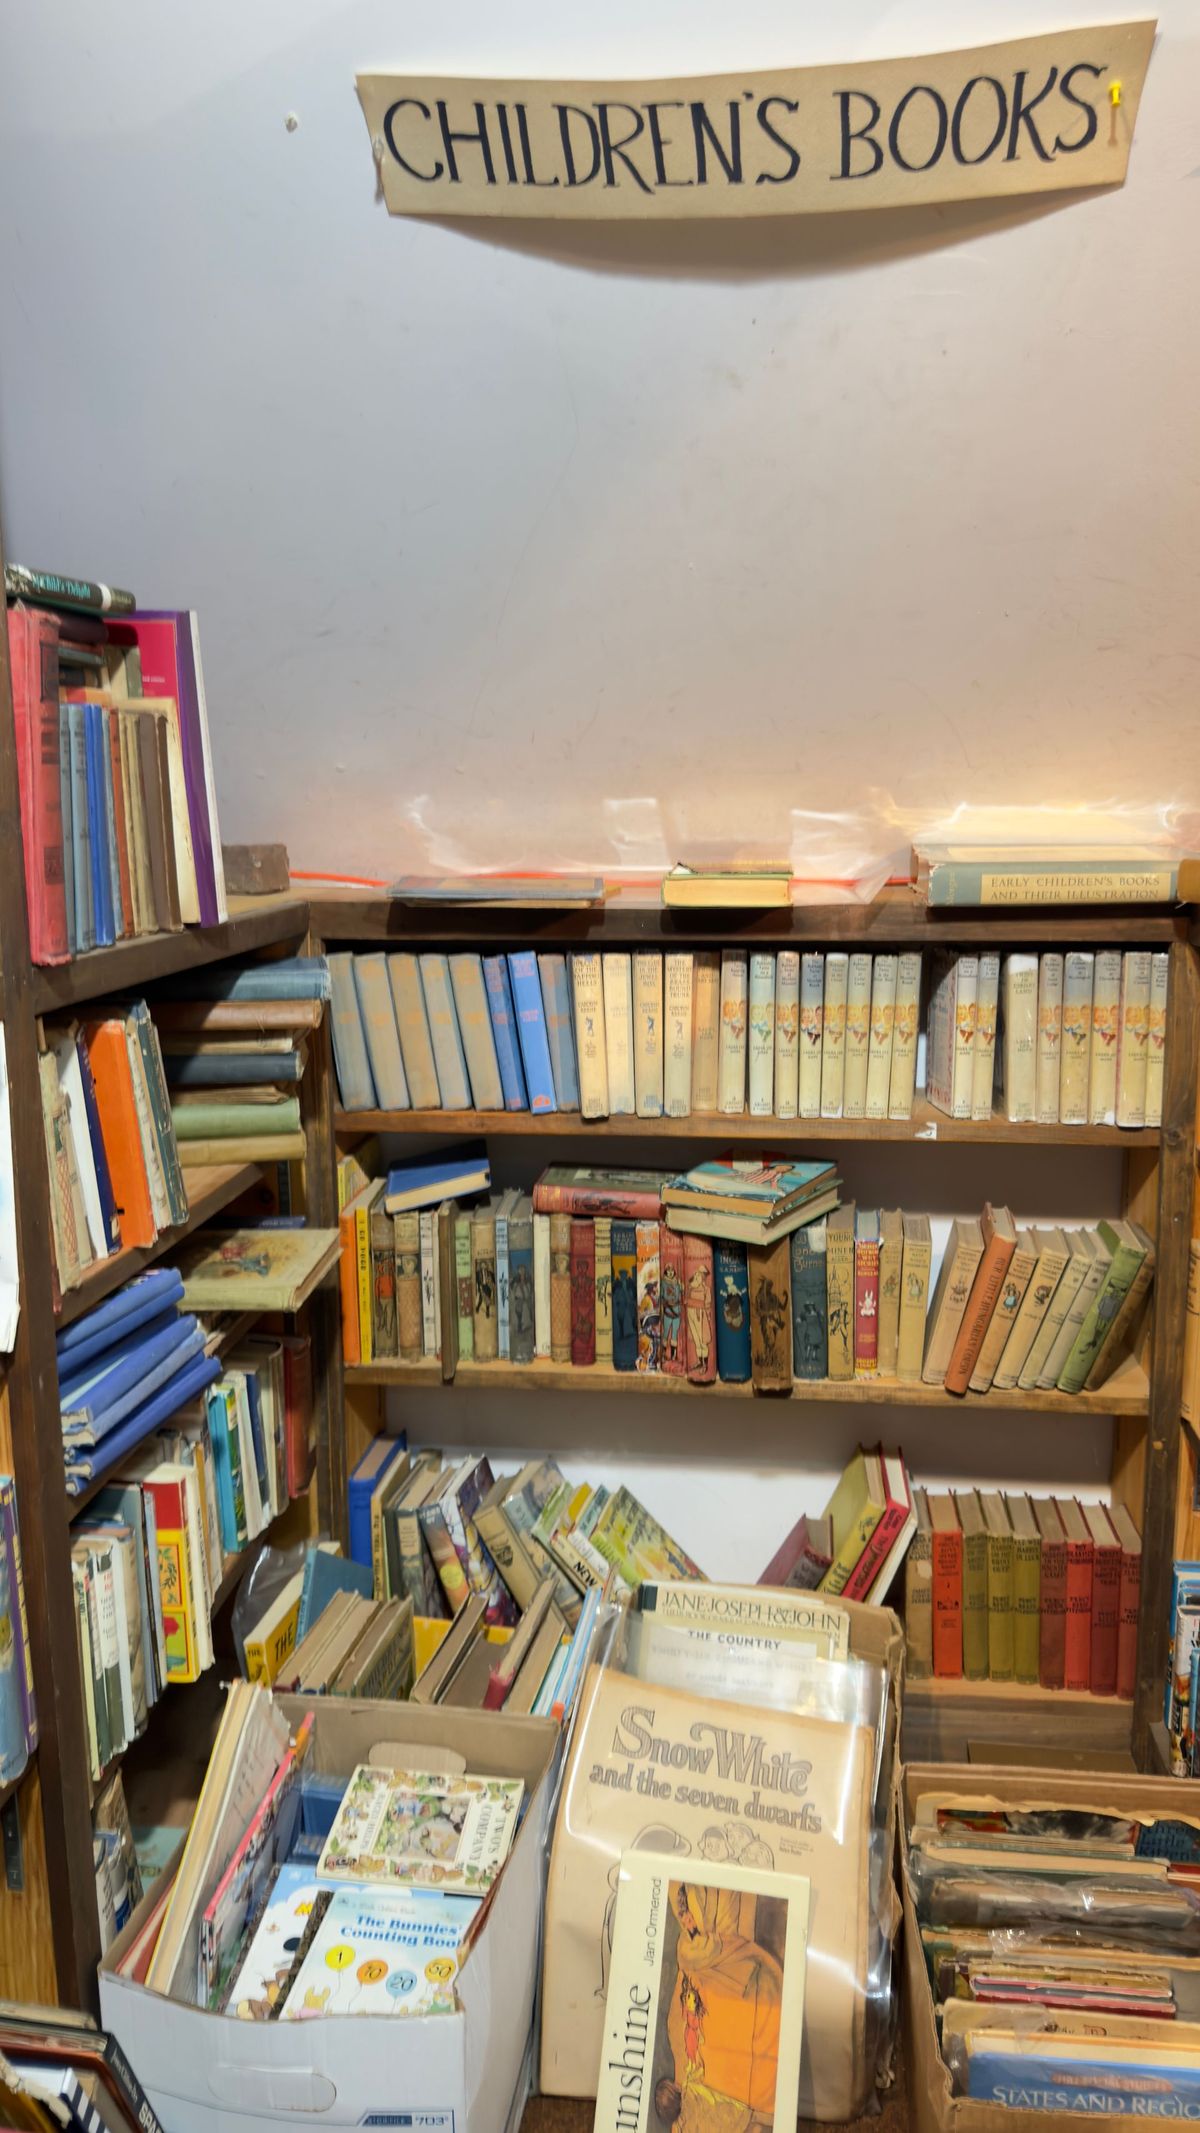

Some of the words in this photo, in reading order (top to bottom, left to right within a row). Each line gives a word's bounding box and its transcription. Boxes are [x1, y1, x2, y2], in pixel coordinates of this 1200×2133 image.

[383, 91, 801, 194] CHILDREN'S
[830, 63, 1107, 182] BOOKS
[991, 876, 1029, 888] EARLY
[1036, 875, 1113, 888] CHILDREN'S
[1119, 874, 1160, 887] BOOKS
[991, 890, 1018, 901] AND
[1024, 889, 1061, 900] THEIR
[1066, 888, 1159, 900] ILLUSTRATION
[574, 1561, 597, 1587] NEW
[274, 1622, 295, 1664] THE
[688, 1630, 711, 1641] THE
[718, 1634, 781, 1650] COUNTRY
[612, 1705, 715, 1774] Snow
[689, 1721, 813, 1797] White
[589, 1761, 633, 1791] and
[637, 1766, 672, 1800] the
[674, 1784, 740, 1816] seven
[744, 1790, 822, 1834] dwarfs
[469, 1803, 493, 1861] COMPANY
[645, 1877, 662, 1938] Ormerod
[340, 1926, 418, 1947] Counting
[356, 1914, 386, 1928] The
[389, 1917, 463, 1936] Bunnies'
[643, 1940, 657, 1967] Jan
[391, 1975, 414, 1990] 20
[992, 2086, 1068, 2108] STATES
[1072, 2092, 1126, 2113] AND
